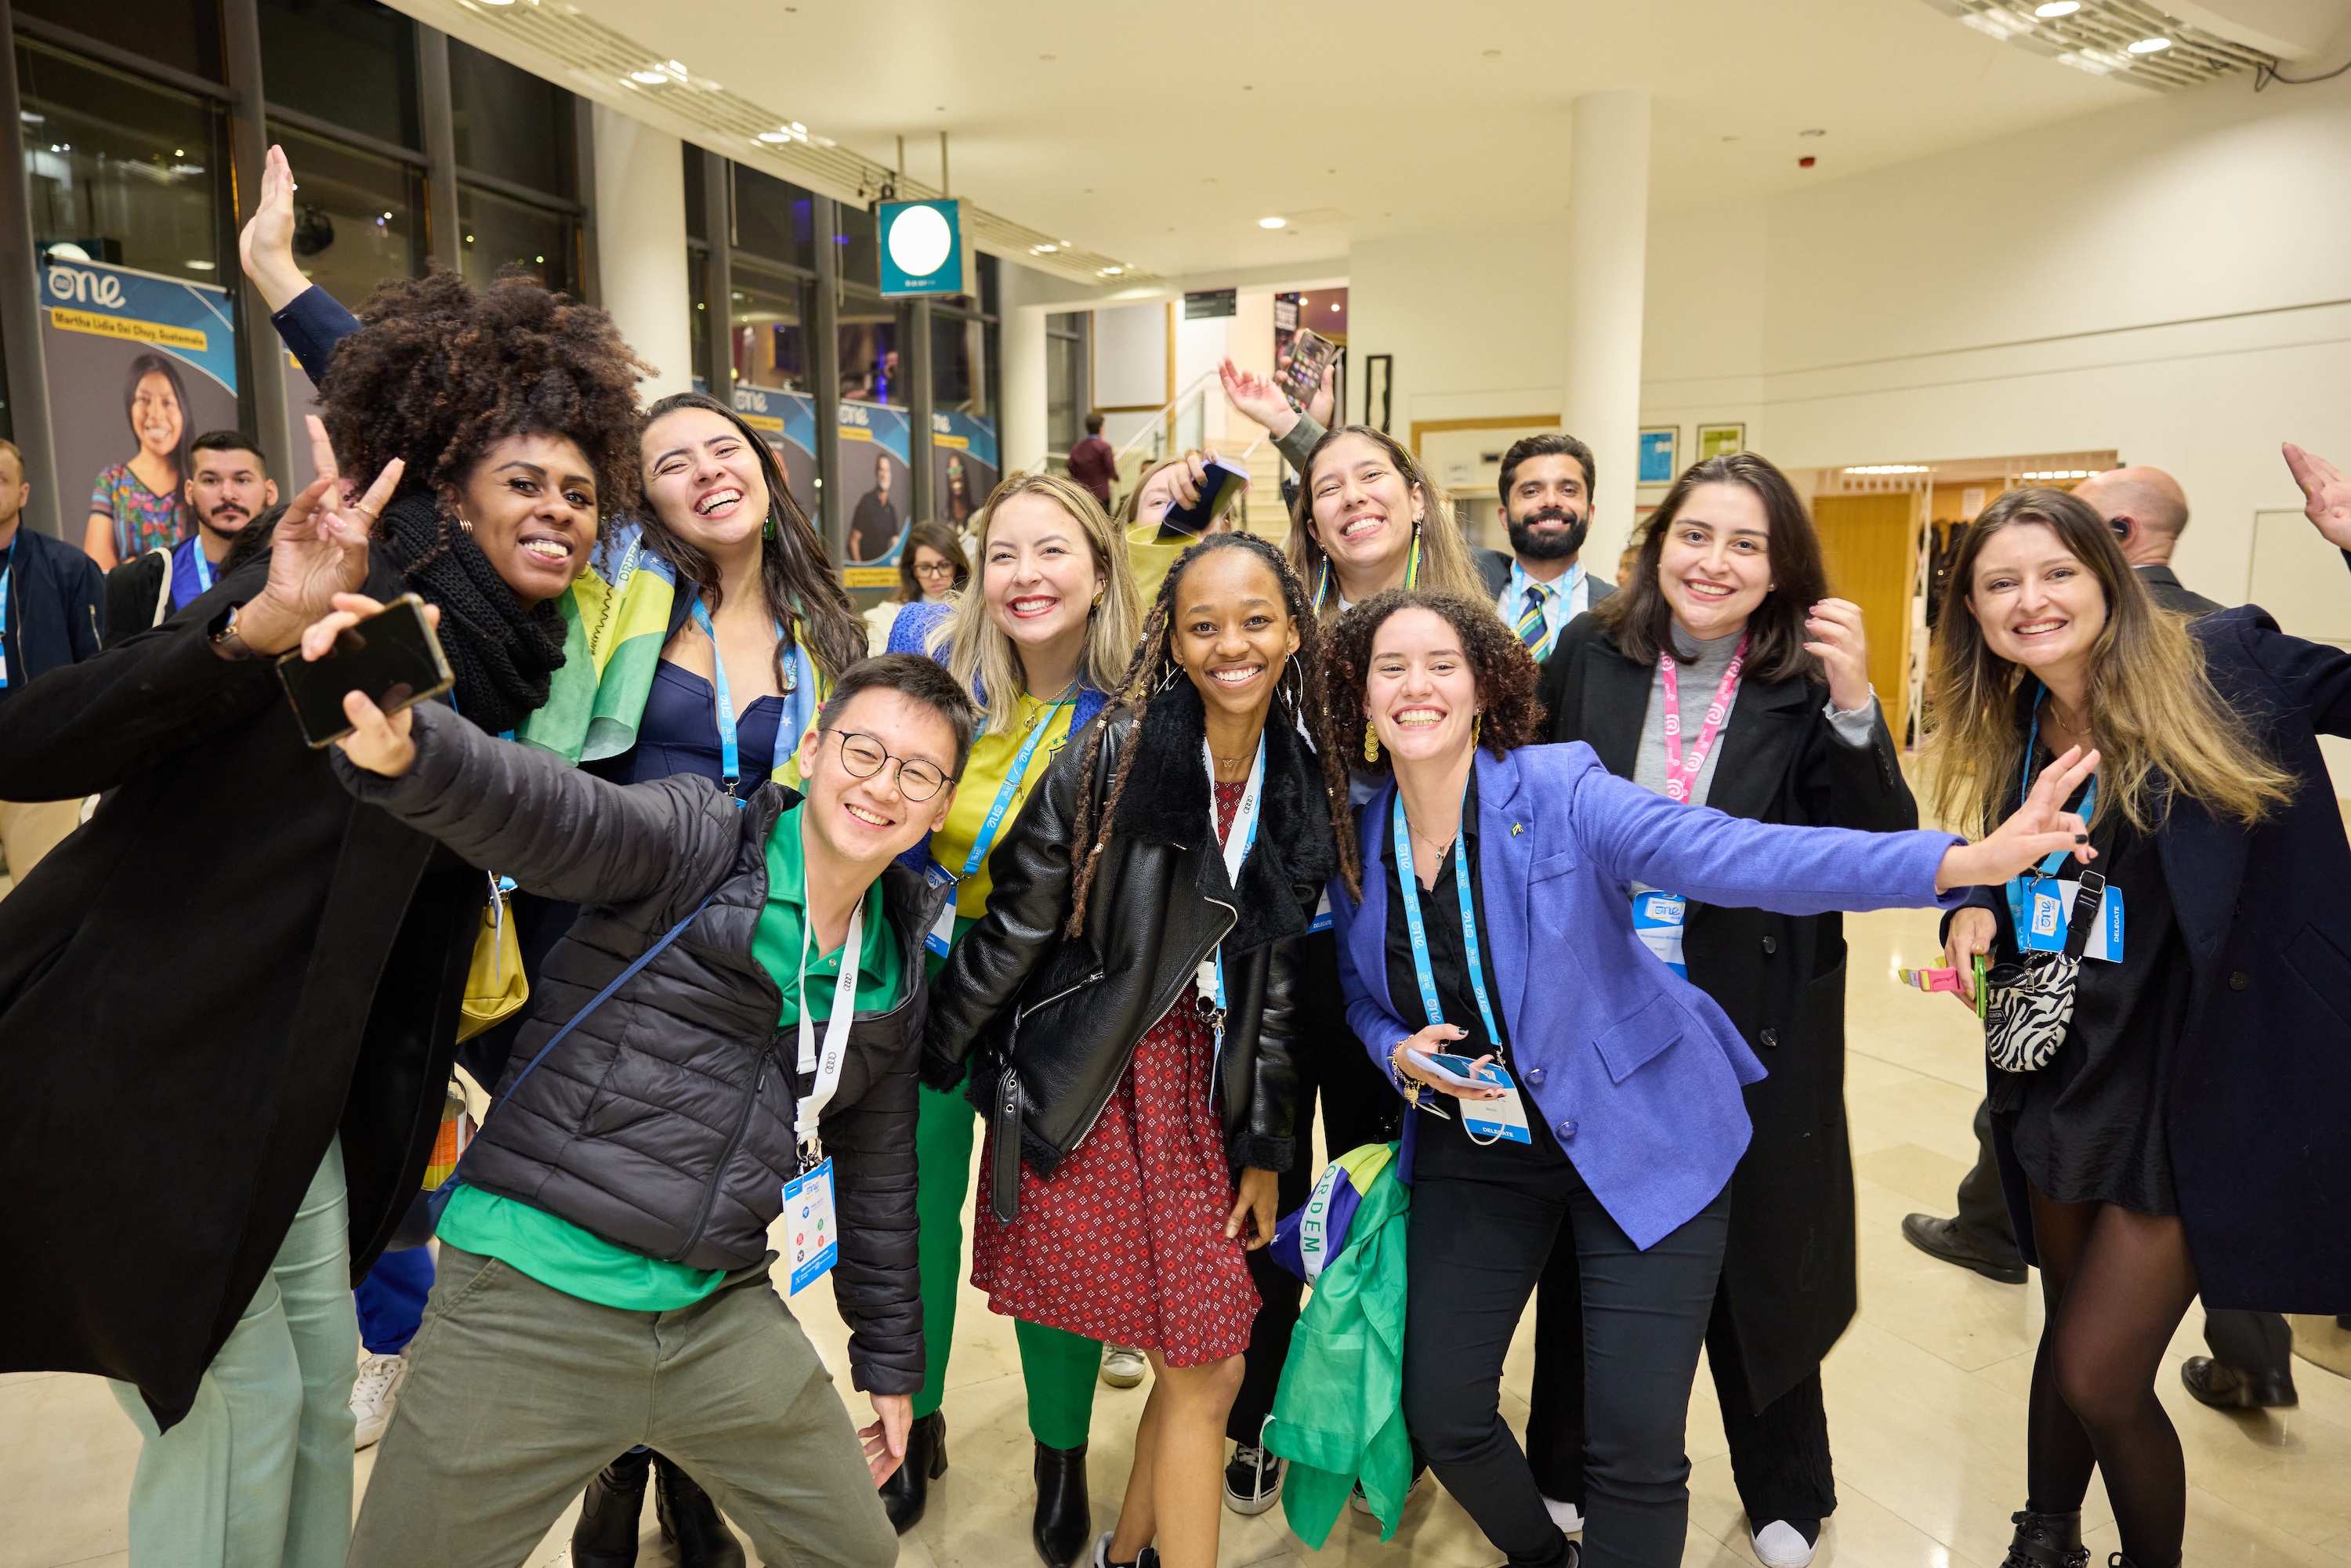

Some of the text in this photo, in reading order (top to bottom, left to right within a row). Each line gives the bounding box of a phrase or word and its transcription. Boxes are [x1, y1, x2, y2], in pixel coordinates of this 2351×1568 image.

[55, 313, 90, 328] Martha
[92, 317, 115, 331] Lidia
[933, 413, 951, 433] ne
[1398, 843, 1411, 871] one
[1313, 919, 1332, 929] DELEGATE
[1463, 909, 1474, 939] one
[2041, 900, 2052, 927] one
[1411, 921, 1424, 949] one
[1426, 998, 1441, 1023] one
[1475, 986, 1489, 1013] one
[1303, 1164, 1337, 1252] ORDEM
